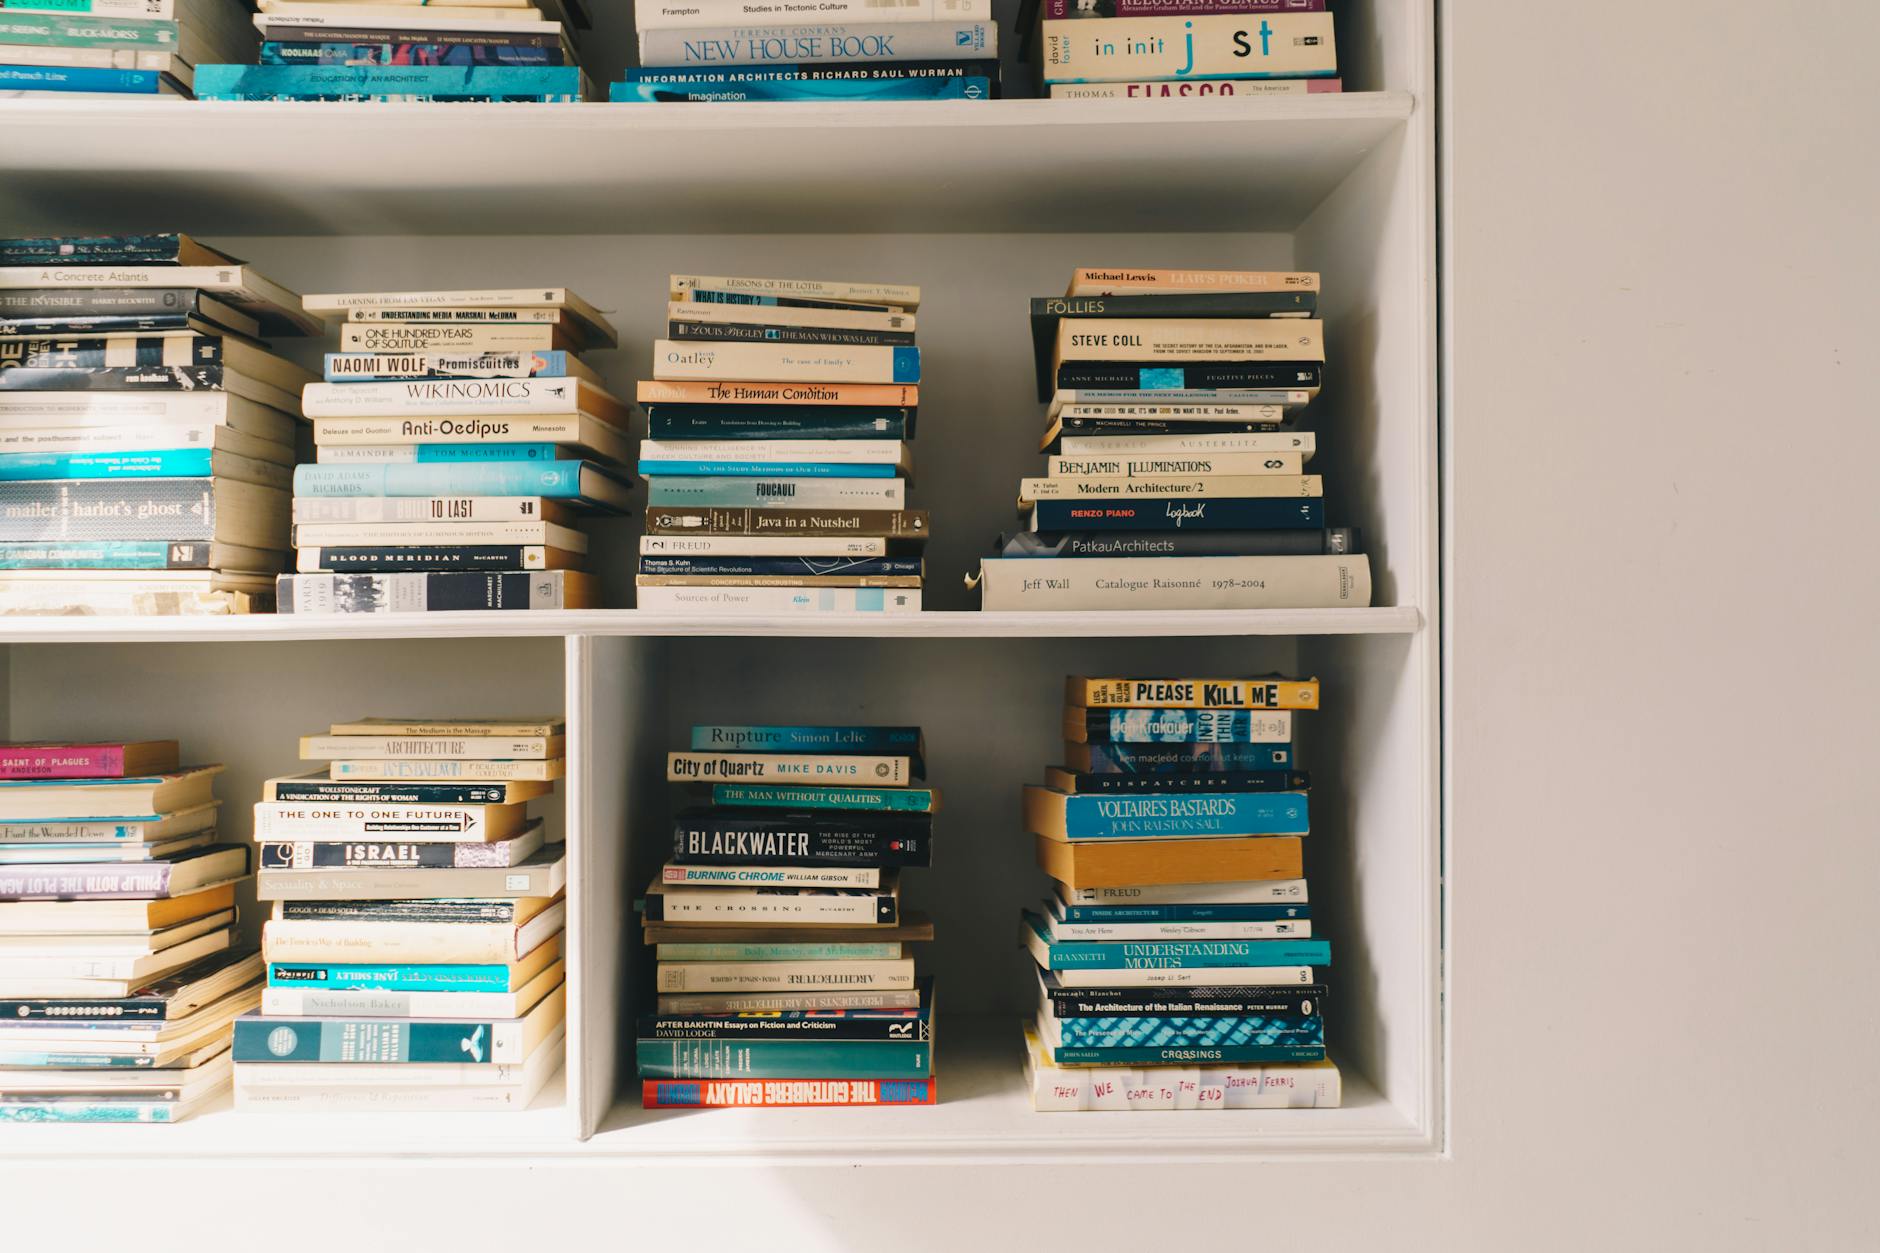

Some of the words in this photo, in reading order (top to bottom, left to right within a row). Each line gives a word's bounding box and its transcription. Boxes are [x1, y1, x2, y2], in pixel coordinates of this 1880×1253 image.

[662, 8, 700, 16] Frampton
[743, 5, 772, 13] Studies
[775, 4, 782, 12] in
[784, 4, 816, 12] Tectonic
[818, 3, 848, 11] Culture
[684, 40, 740, 62] NEW
[750, 38, 822, 60] HOUSE
[831, 35, 894, 58] BOOK
[1049, 36, 1059, 64] david
[1061, 36, 1070, 64] foster
[1096, 39, 1114, 56] in
[1127, 37, 1164, 55] init
[1176, 21, 1194, 75] j
[639, 74, 725, 83] INFORMATION
[729, 72, 808, 81] ARCHITECTS
[813, 70, 868, 79] RICHARD
[873, 69, 904, 78] SAUL
[909, 68, 963, 77] WURMAN
[688, 92, 746, 101] Imagination
[41, 272, 50, 281] A
[54, 271, 104, 282] Concrete
[109, 272, 148, 282] Atlantis
[1085, 272, 1124, 281] Michael
[1126, 273, 1156, 282] Lewis
[6, 297, 28, 306] THE
[30, 295, 84, 306] INVISIBLE
[1046, 301, 1104, 314] FOLLIES
[381, 312, 430, 320] UNDERSTANDING
[432, 312, 452, 320] MEDIA
[455, 312, 487, 320] MARSHALL
[366, 329, 389, 339] ONE
[392, 329, 440, 338] HUNDRED
[442, 329, 472, 338] YEARS
[366, 340, 381, 348] OF
[381, 340, 428, 348] SOLITUDE
[1072, 335, 1108, 347] STEVE
[1113, 335, 1142, 346] COLL
[333, 358, 381, 373] NAOMI
[387, 357, 426, 372] WOLF
[439, 358, 519, 370] Promiscuities
[668, 352, 715, 368] Oatley
[407, 382, 530, 399] WIKINOMICS
[707, 383, 731, 399] The
[734, 388, 779, 401] Human
[782, 387, 839, 401] Condition
[402, 420, 509, 438] Anti-Oedipus
[1059, 461, 1120, 475] BENJAMIN
[1127, 460, 1212, 477] ILLUMINATIONS
[756, 483, 796, 497] FOUCAULT
[1077, 484, 1120, 494] Modern
[1125, 482, 1204, 494] Architecture/2
[7, 502, 57, 517] mailer
[73, 501, 131, 517] harlot's
[138, 501, 182, 518] ghost
[432, 500, 443, 518] TO
[448, 499, 473, 518] LAST
[1071, 509, 1103, 517] RENZO
[1106, 509, 1135, 517] PIANO
[756, 516, 782, 530] Java
[785, 516, 798, 528] in
[800, 519, 807, 528] a
[810, 516, 860, 529] Nutshell
[672, 541, 711, 550] FREUD
[330, 554, 378, 562] BLOOD
[1022, 578, 1042, 592] Jeff
[1046, 578, 1070, 589] Wall
[1095, 578, 1149, 591] Catalogue
[1152, 576, 1202, 589] Raisonné
[1212, 578, 1265, 590] 1978–2004
[1136, 683, 1194, 701] PLEASE
[1204, 684, 1244, 706] KILL
[1252, 685, 1278, 706] ME
[1198, 713, 1214, 742] INTO
[1217, 714, 1231, 742] THIN
[712, 728, 782, 748] Rupture
[790, 732, 830, 743] Simon
[835, 732, 866, 743] Lelic
[385, 741, 466, 755] ARCHITECTURE
[3, 758, 30, 766] SAINT
[35, 758, 47, 766] OF
[52, 757, 90, 766] PLAGUES
[674, 758, 700, 776] City
[703, 760, 716, 775] of
[719, 760, 764, 776] Quartz
[777, 764, 810, 773] MIKE
[817, 765, 857, 774] DAVIS
[724, 790, 744, 799] THE
[748, 790, 773, 800] MAN
[776, 792, 824, 802] WITHOUT
[829, 793, 881, 804] QUALITIES
[1170, 799, 1236, 817] BASTARDS
[278, 811, 305, 819] THE
[311, 811, 341, 819] ONE
[688, 831, 809, 856] BLACKWATER
[346, 845, 420, 860] ISRAEL
[687, 870, 737, 880] BURNING
[738, 871, 785, 882] CHROME
[1103, 888, 1141, 897] FREUD
[1124, 944, 1249, 956] UNDERSTANDING
[1053, 953, 1106, 961] GIANNETTI
[1125, 957, 1182, 969] MOVIES
[787, 974, 874, 984] ARCHITECTURE
[1078, 1003, 1093, 1011] The
[1095, 1003, 1143, 1012] Architecture
[1145, 1003, 1153, 1011] of
[1154, 1003, 1167, 1011] the
[1169, 1003, 1193, 1011] Italian
[1194, 1002, 1243, 1012] Renaissance
[724, 1021, 748, 1030] Essays
[1161, 1050, 1222, 1059] CROSSINGS
[1225, 1076, 1257, 1088] JOSHUA
[1265, 1076, 1295, 1088] FERRIS
[706, 1082, 763, 1105] GALAXY
[765, 1081, 848, 1104] GUTENBERG
[849, 1081, 877, 1103] THE
[1053, 1087, 1078, 1098] THEN
[1094, 1083, 1114, 1098] WE
[1127, 1089, 1155, 1100] CAME
[1160, 1088, 1172, 1099] TO
[1179, 1081, 1196, 1092] THE
[1199, 1089, 1222, 1101] END
